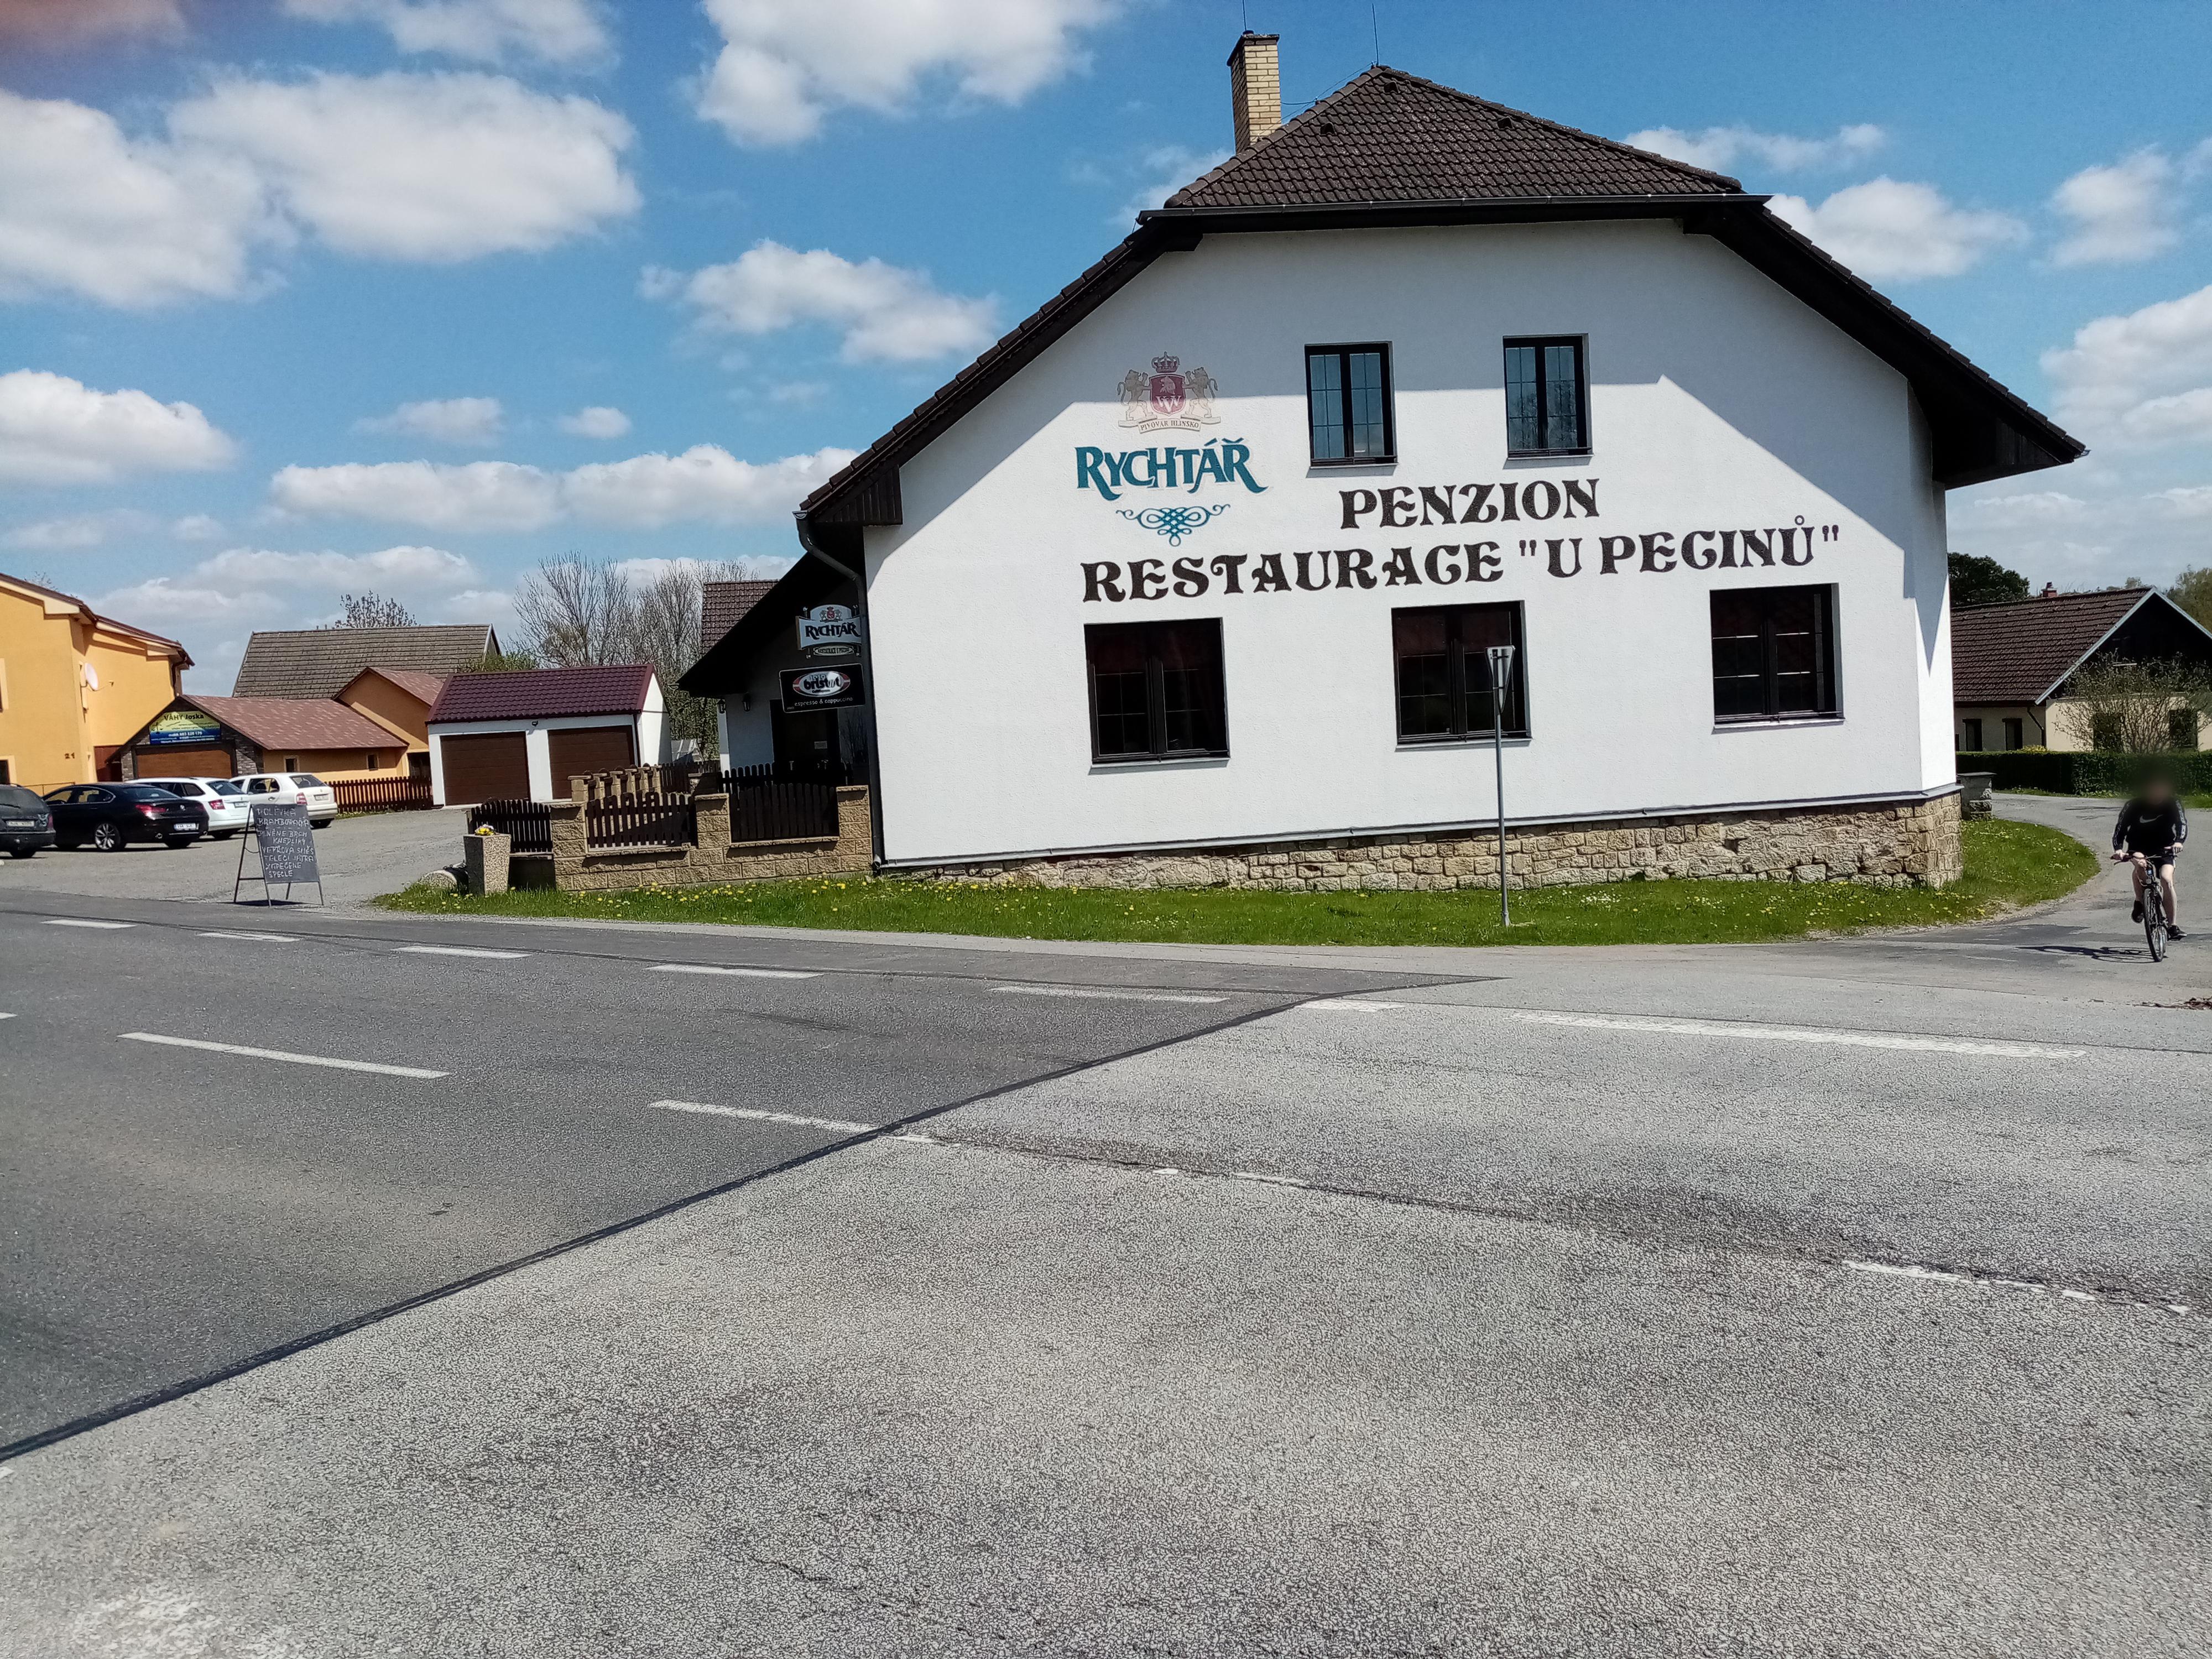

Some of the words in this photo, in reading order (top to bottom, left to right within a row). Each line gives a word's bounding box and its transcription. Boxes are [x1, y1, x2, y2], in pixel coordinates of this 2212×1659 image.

[1140, 420, 1168, 431] PIVOVAR
[1171, 420, 1199, 429] HLINSKO
[1075, 437, 1269, 501] RYCHTÁŘ
[1339, 478, 1600, 530] PENZION
[1080, 541, 1504, 603] RESTAURACE
[805, 622, 861, 640] RYCHTÁŘ
[825, 697, 853, 705] cappuccino
